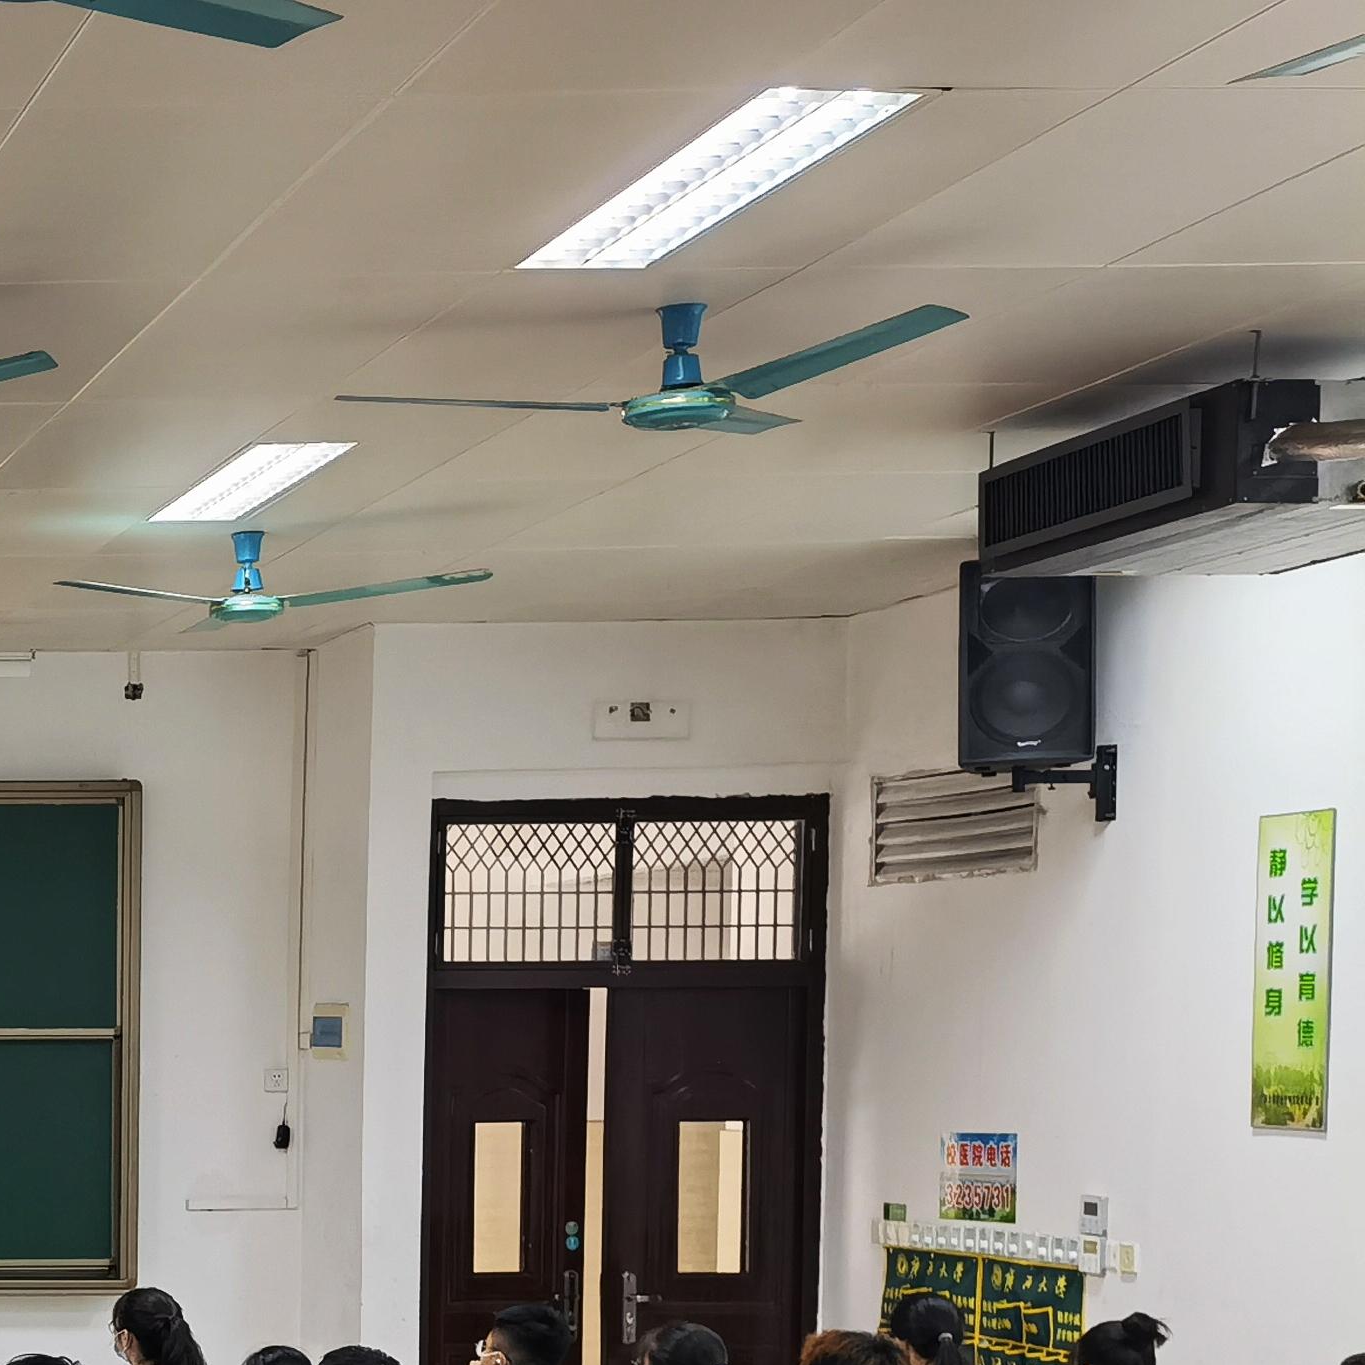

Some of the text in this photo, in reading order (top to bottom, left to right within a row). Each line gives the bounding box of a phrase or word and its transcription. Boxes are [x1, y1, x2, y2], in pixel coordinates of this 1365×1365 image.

[1265, 848, 1287, 1017] 静以修身
[1297, 876, 1319, 1048] 学以育德
[945, 1183, 1012, 1210] 3235731
[946, 1143, 1013, 1168] 校医院电话
